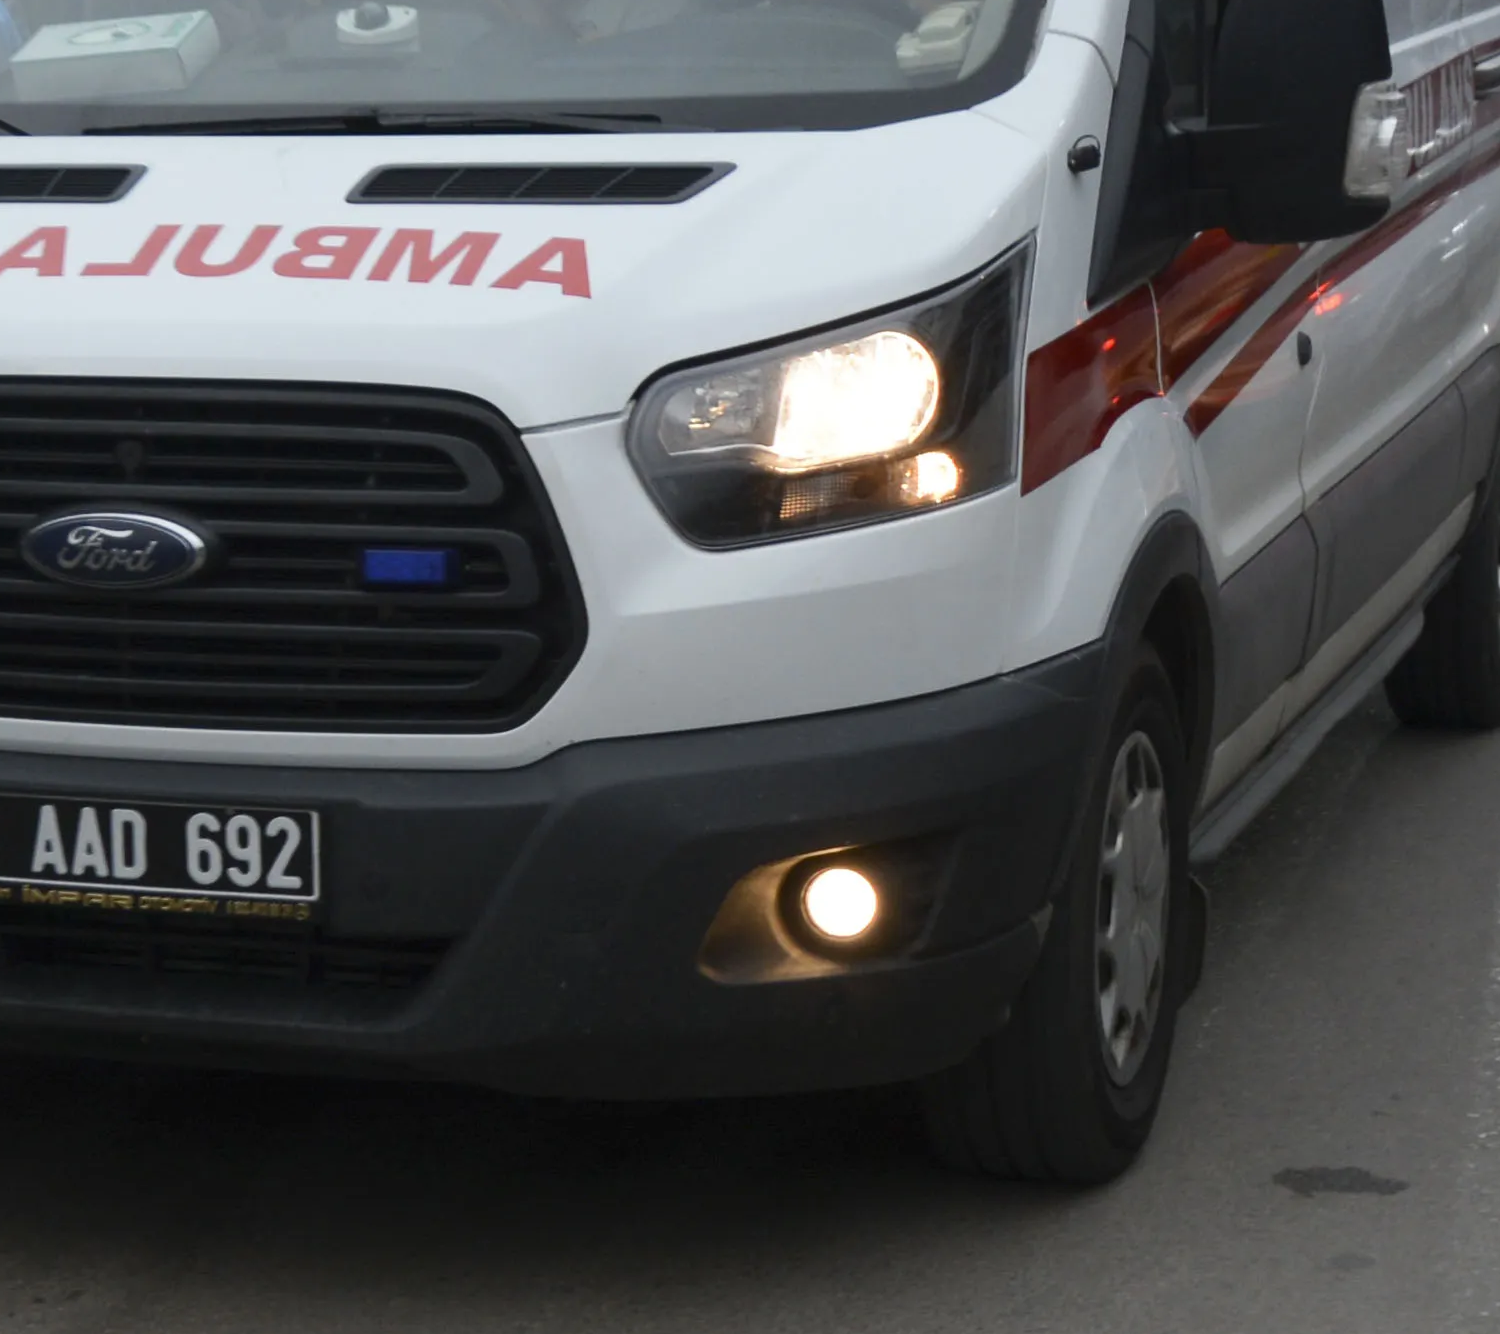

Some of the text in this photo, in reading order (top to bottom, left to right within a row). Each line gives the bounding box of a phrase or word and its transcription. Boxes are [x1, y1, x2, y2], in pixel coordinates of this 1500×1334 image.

[55, 524, 157, 576] Ford
[31, 804, 148, 880] AAD
[185, 812, 304, 889] 692
